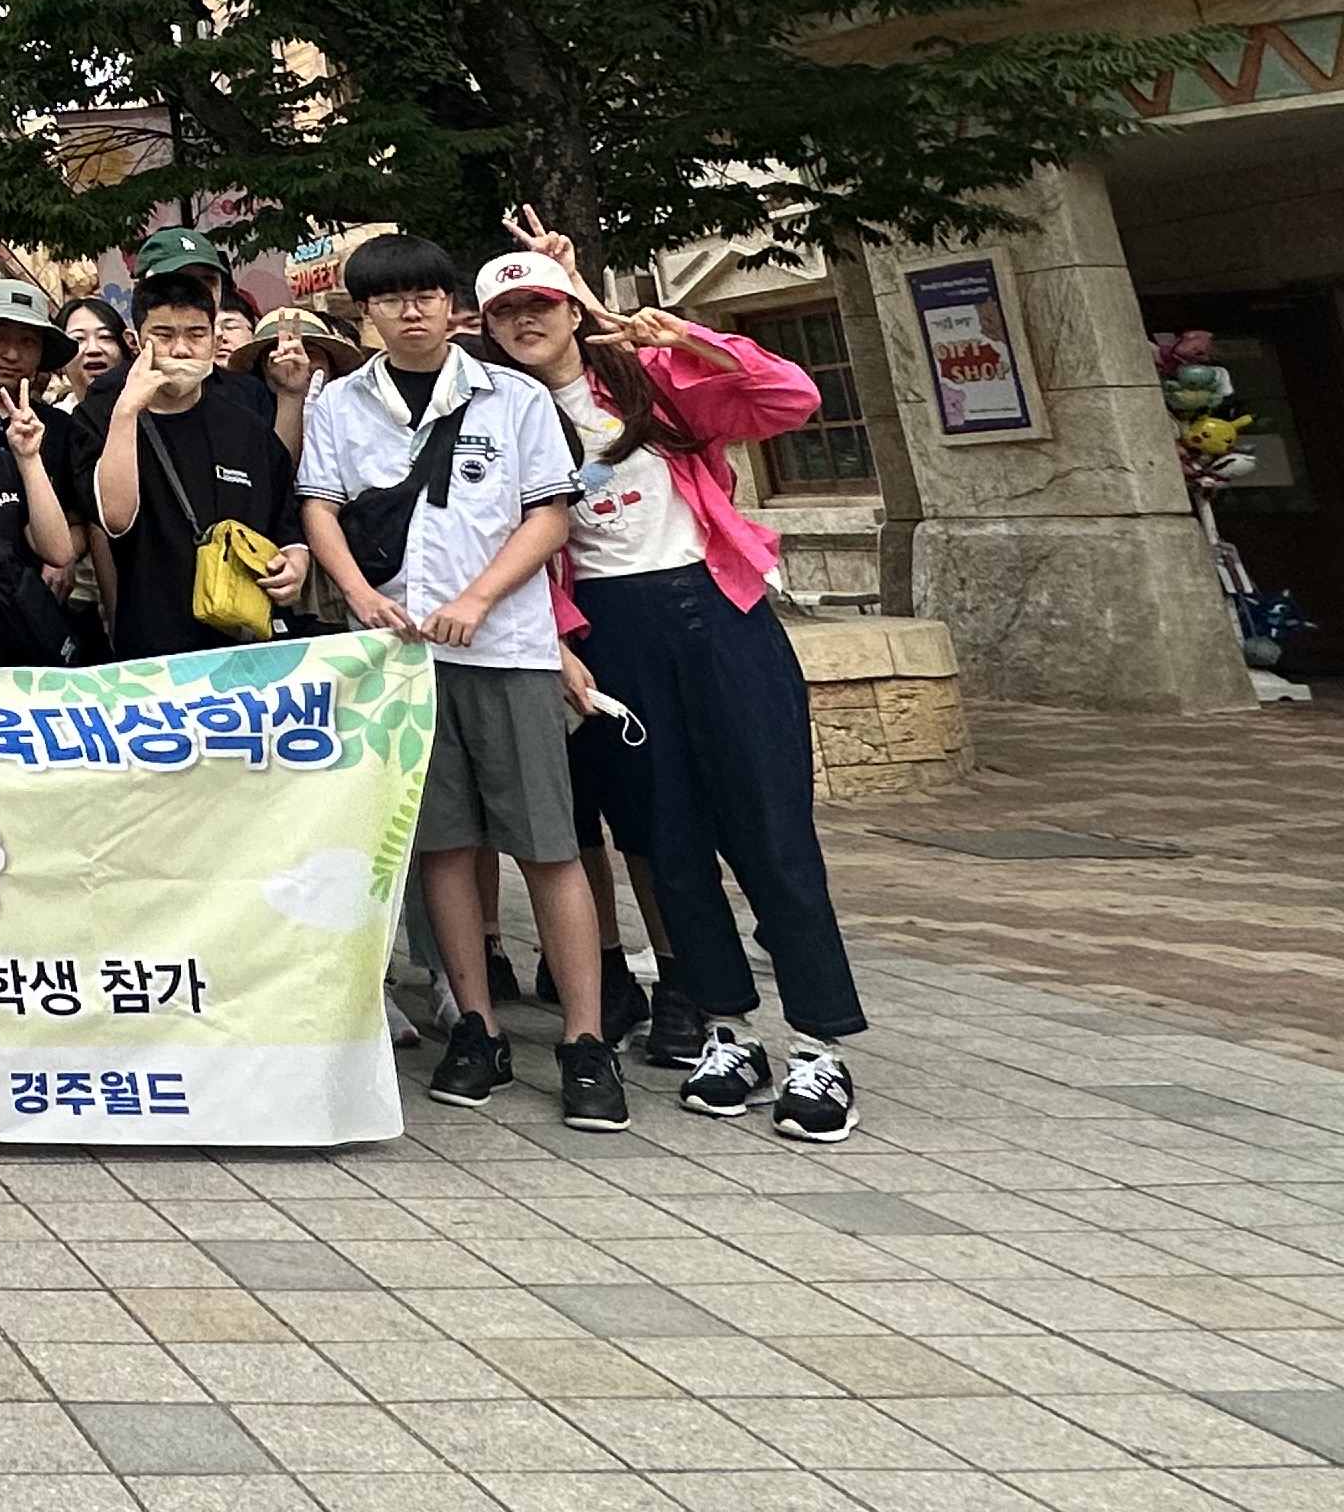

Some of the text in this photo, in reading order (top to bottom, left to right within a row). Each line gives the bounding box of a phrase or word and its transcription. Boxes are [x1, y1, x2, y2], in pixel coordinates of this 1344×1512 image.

[935, 339, 981, 360] GIFT
[952, 361, 1010, 384] SHOP
[101, 958, 205, 1014] 참가
[11, 1070, 190, 1117] 경주월드
